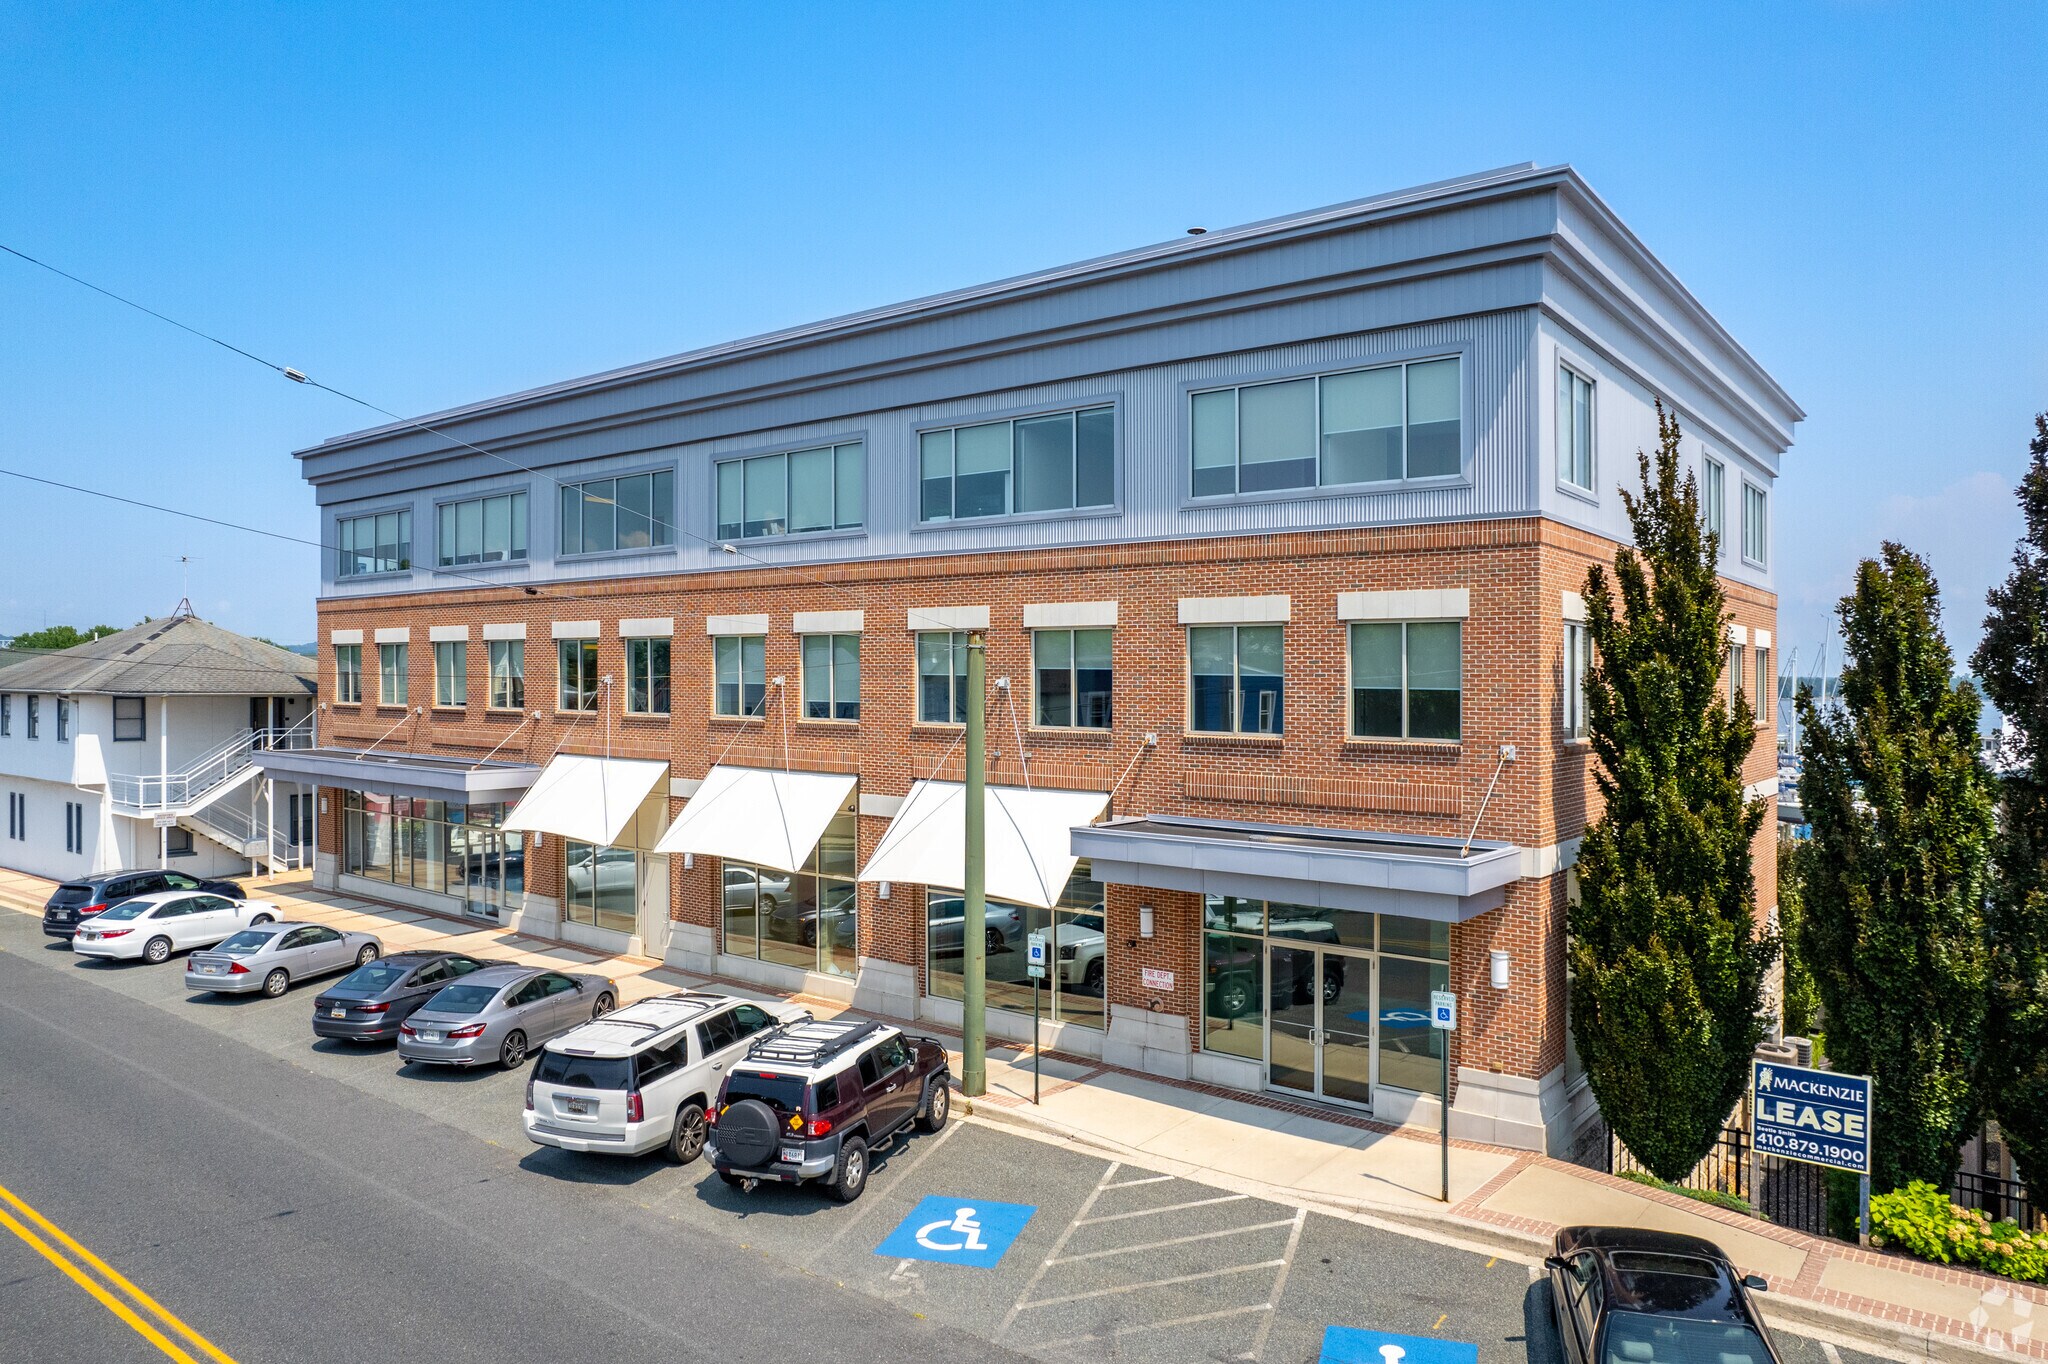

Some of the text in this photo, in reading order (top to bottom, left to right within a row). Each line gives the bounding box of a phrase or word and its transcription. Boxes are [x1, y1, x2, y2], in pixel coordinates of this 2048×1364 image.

[1143, 978, 1173, 989] CONNECTION
[1145, 970, 1155, 978] FIRE
[1773, 1077, 1865, 1103] MACKENZIE
[1756, 1098, 1865, 1138] LEASE
[1778, 1129, 1797, 1138] Smith
[1756, 1133, 1865, 1163] 410.879.1900
[1756, 1144, 1865, 1170] mackenziecommercial.com
